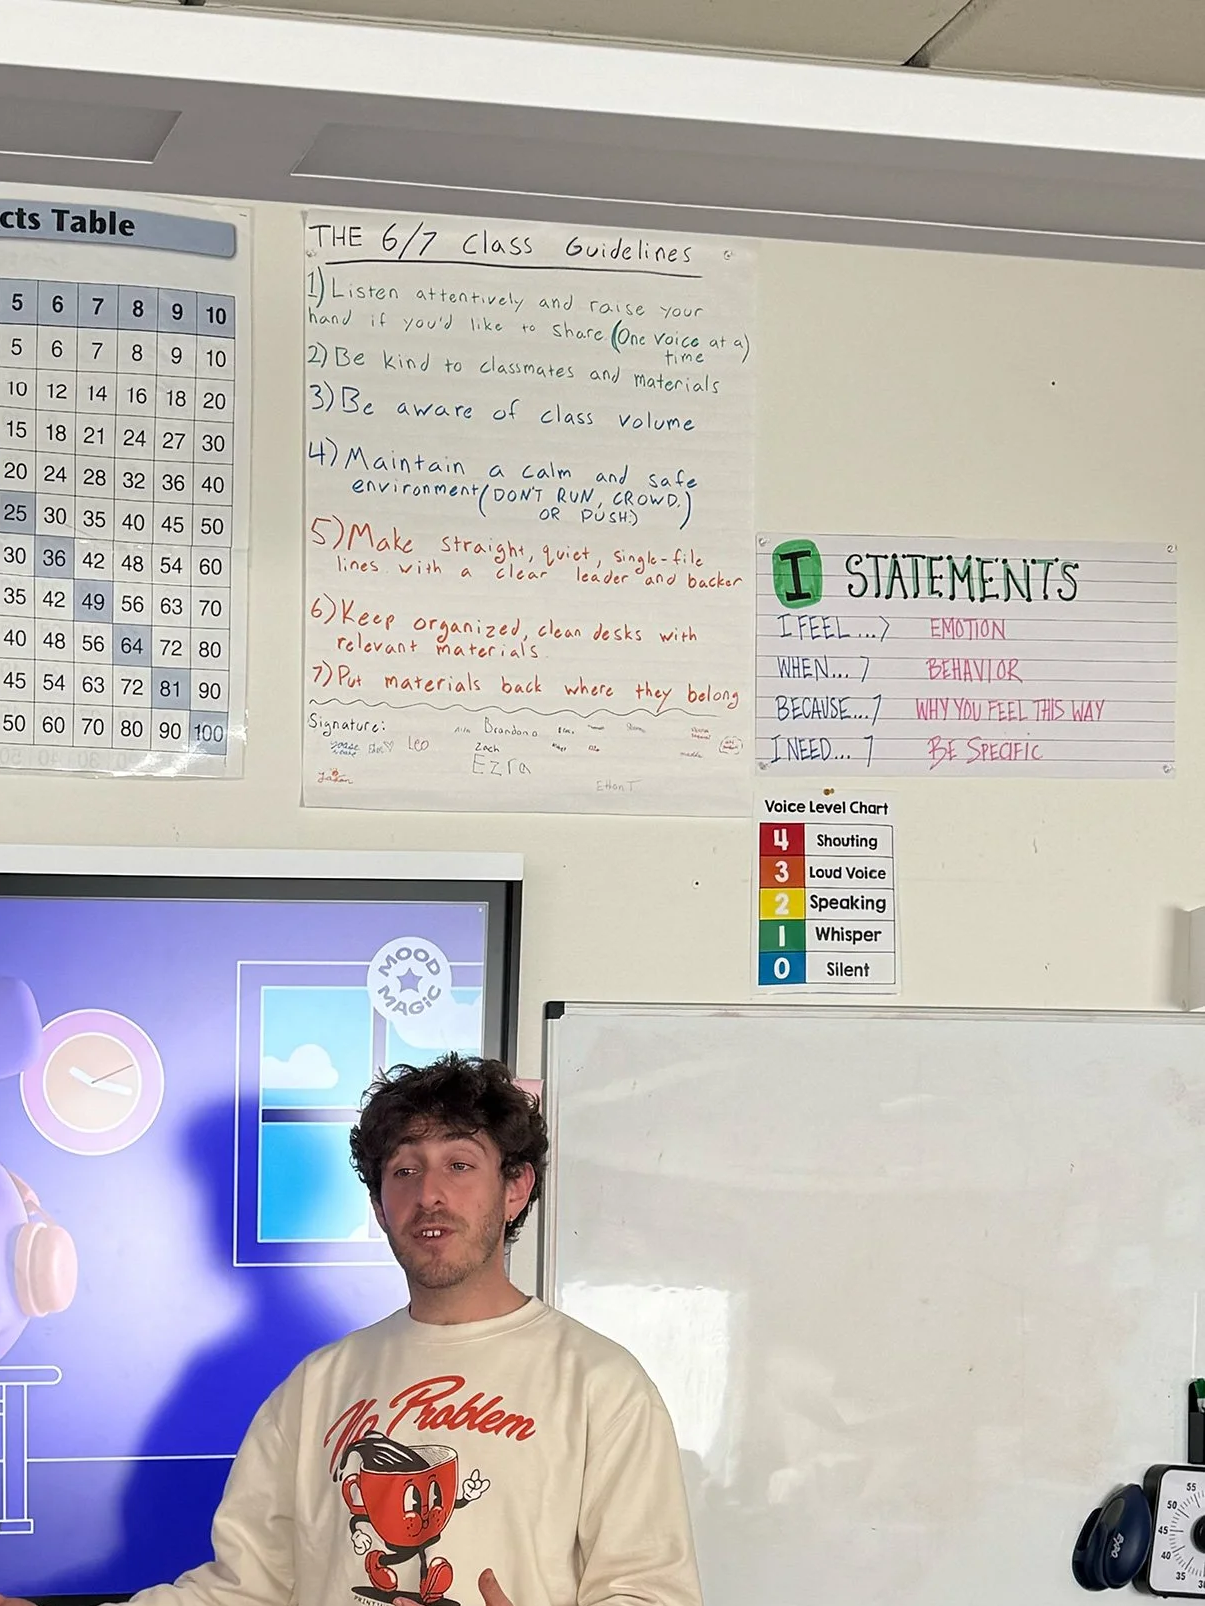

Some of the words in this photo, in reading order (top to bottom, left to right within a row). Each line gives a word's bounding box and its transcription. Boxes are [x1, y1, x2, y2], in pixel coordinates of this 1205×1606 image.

[51, 208, 135, 237] Table
[308, 225, 362, 247] THE
[383, 223, 437, 256] 6/7
[463, 230, 532, 255] Class
[566, 236, 691, 262] Guidelines
[12, 294, 22, 310] 5
[53, 296, 63, 313] 6
[93, 298, 103, 314] 7
[133, 300, 143, 317] 8
[172, 304, 182, 320] 9
[207, 307, 226, 324] 10
[333, 277, 398, 300] Listen
[416, 288, 523, 312] attentively
[539, 295, 572, 310] and
[590, 301, 645, 316] raise
[660, 307, 703, 319] your
[335, 346, 364, 366] Be
[383, 350, 429, 371] kind
[445, 359, 462, 373] to
[480, 356, 574, 378] classmates
[590, 366, 620, 383] and
[634, 374, 719, 393] materials
[342, 386, 374, 415] Be
[397, 403, 472, 419] aware
[493, 399, 520, 420] of
[541, 404, 593, 425] class
[619, 411, 695, 431] volume
[345, 447, 465, 475] Maintain
[489, 465, 504, 477] a
[522, 462, 571, 479] calm
[596, 465, 628, 485] and
[649, 469, 697, 488] safe
[540, 507, 560, 520] OR
[779, 551, 811, 601] I
[845, 553, 1080, 602] STATEMENTS
[930, 618, 1006, 640] EMOTION
[926, 658, 1023, 683] BEHAVIOR
[338, 665, 361, 688] Put
[385, 672, 480, 692] materials
[502, 674, 541, 694] back
[564, 685, 613, 697] where
[636, 686, 672, 711] they
[688, 683, 738, 709] belong
[915, 699, 949, 722] WHY
[953, 700, 982, 721] YOU
[988, 701, 1028, 721] FEEL
[1033, 700, 1065, 721] THIS
[1071, 700, 1105, 722] WAY
[309, 713, 385, 737] Signature:
[472, 753, 531, 776] Ezra
[927, 735, 958, 770] BE
[966, 737, 1043, 762] SPECIFIC
[765, 800, 805, 812] Voice
[810, 801, 845, 813] Level
[850, 802, 888, 815] Chart
[773, 828, 789, 850] 4
[817, 834, 877, 850] Shouting
[774, 860, 789, 883] 3
[810, 867, 841, 878] Loud
[846, 867, 886, 879] Voice
[774, 892, 790, 916] 2
[811, 895, 885, 913] Speaking
[778, 925, 785, 947] 1
[816, 927, 881, 944] Whisper
[378, 947, 441, 977] MOOD
[773, 956, 791, 980] 0
[827, 962, 869, 976] Silent
[386, 1375, 536, 1441] Problem
[1186, 1482, 1196, 1491] 55
[1167, 1500, 1177, 1509] 50
[1158, 1526, 1168, 1534] 45
[1161, 1551, 1171, 1560] 40
[1176, 1572, 1186, 1581] 35
